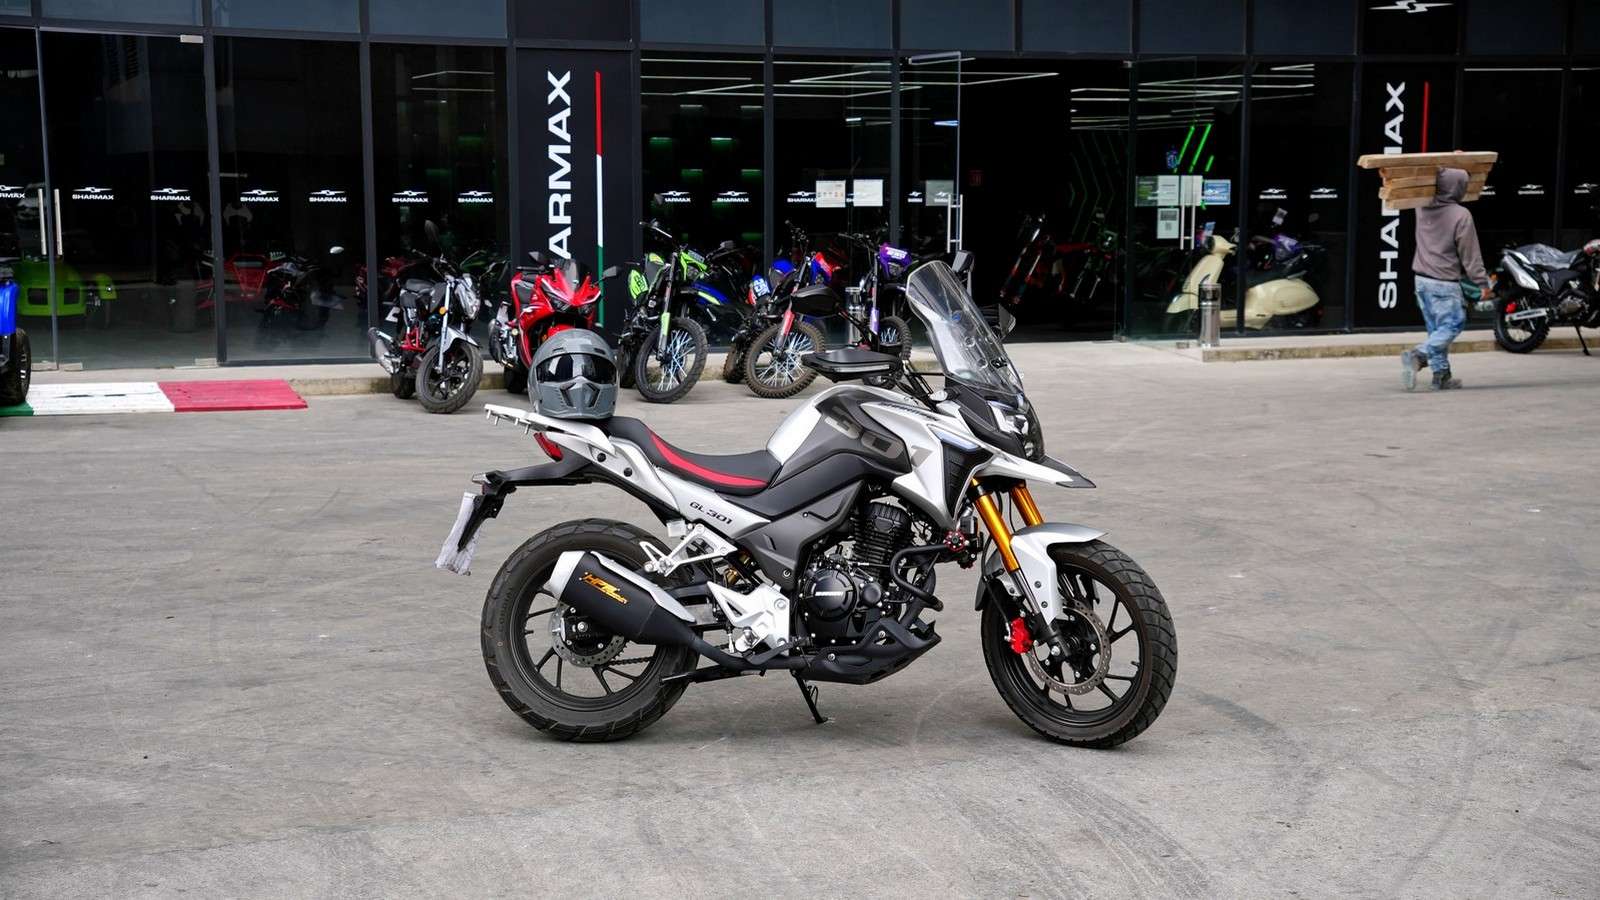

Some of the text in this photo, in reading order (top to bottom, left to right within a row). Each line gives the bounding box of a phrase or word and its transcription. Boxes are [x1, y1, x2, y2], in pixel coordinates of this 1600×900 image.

[71, 193, 115, 201] SHARMAX
[548, 71, 573, 259] ARMAX
[1378, 81, 1406, 309] SHAAX
[689, 501, 733, 525] GL 301
